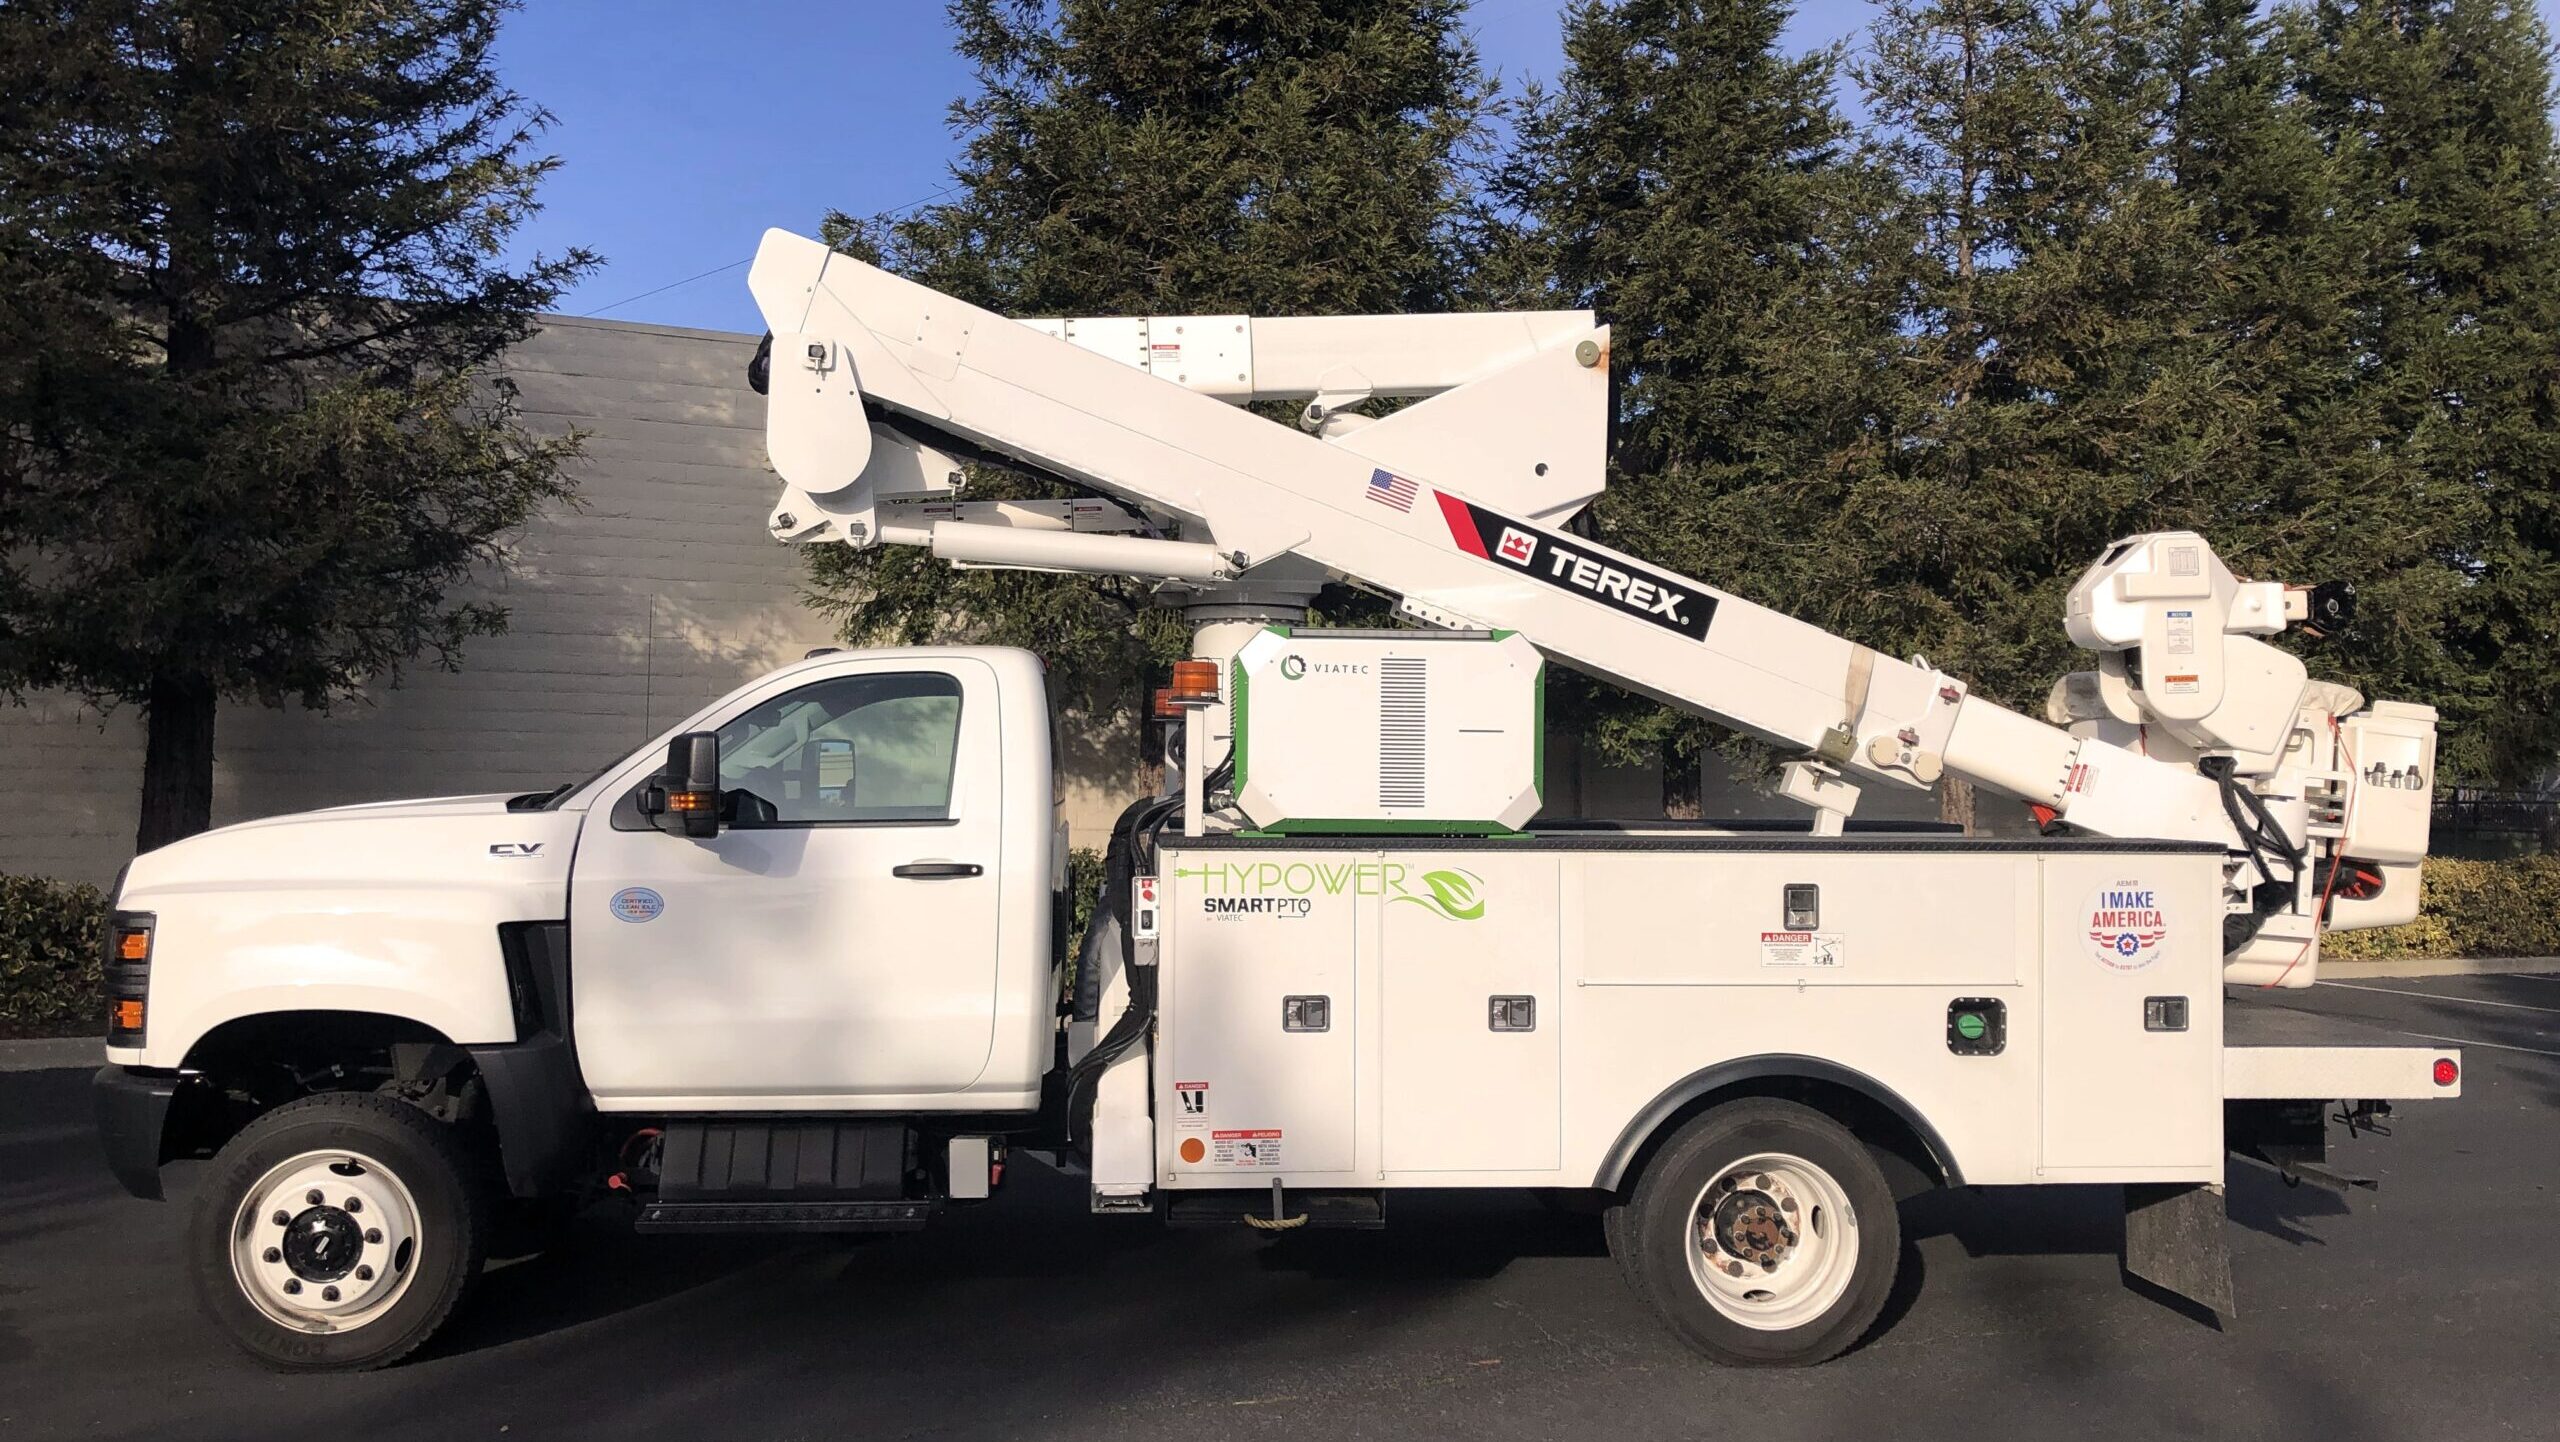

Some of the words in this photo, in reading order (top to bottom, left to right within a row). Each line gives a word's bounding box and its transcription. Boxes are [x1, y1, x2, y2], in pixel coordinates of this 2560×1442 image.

[1550, 546, 1685, 622] TEREX
[1314, 664, 1369, 674] VIATEC
[490, 843, 545, 854] CV
[1203, 863, 1408, 894] HYPOWER
[2101, 892, 2106, 908] I
[2109, 891, 2154, 908] MAKE
[1216, 914, 1244, 922] VIATEC
[2092, 911, 2163, 927] AMERICA
[1772, 934, 1809, 942] DANGER
